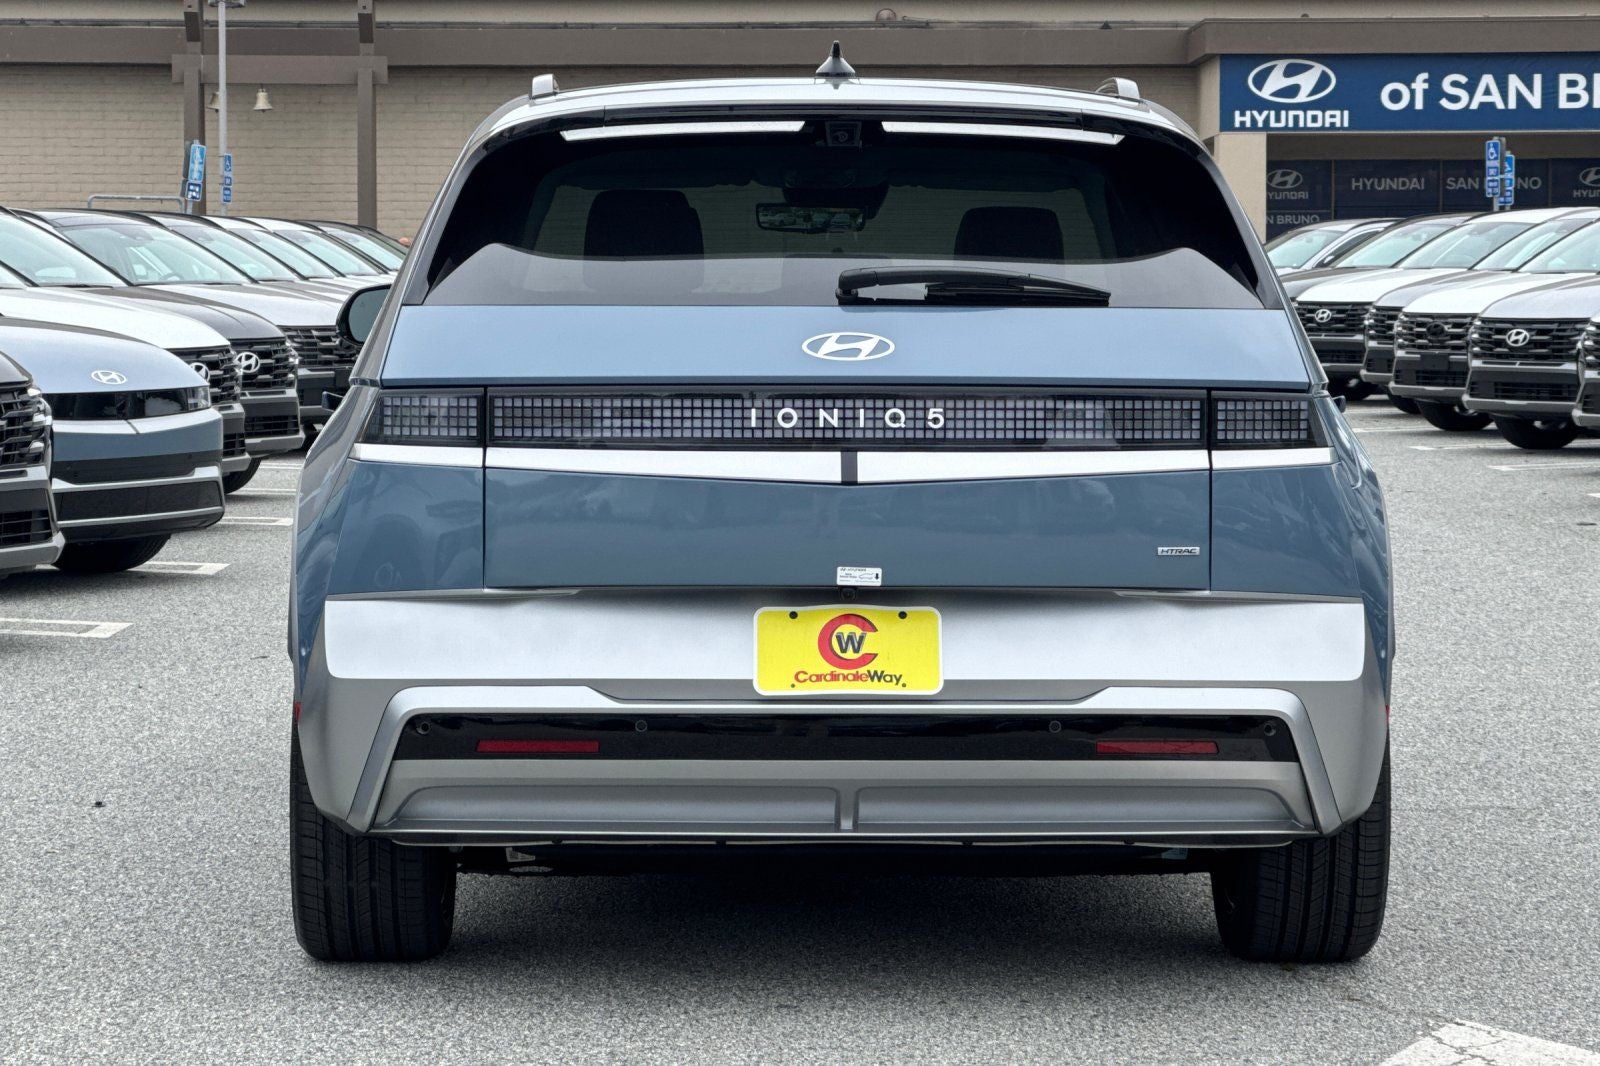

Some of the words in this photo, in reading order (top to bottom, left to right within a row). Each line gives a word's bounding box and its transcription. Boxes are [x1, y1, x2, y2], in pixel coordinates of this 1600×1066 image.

[1380, 72, 1429, 110] of
[1439, 73, 1542, 111] SAN
[1234, 110, 1349, 128] HYUNDAI
[1352, 178, 1425, 190] HYUNDAI
[1446, 178, 1479, 190] SAN
[1266, 191, 1309, 200] YUNDAI
[1276, 214, 1320, 225] BRUNO
[751, 408, 906, 428] IONIQ
[927, 408, 945, 429] 5
[794, 669, 903, 685] CardinaleWay
